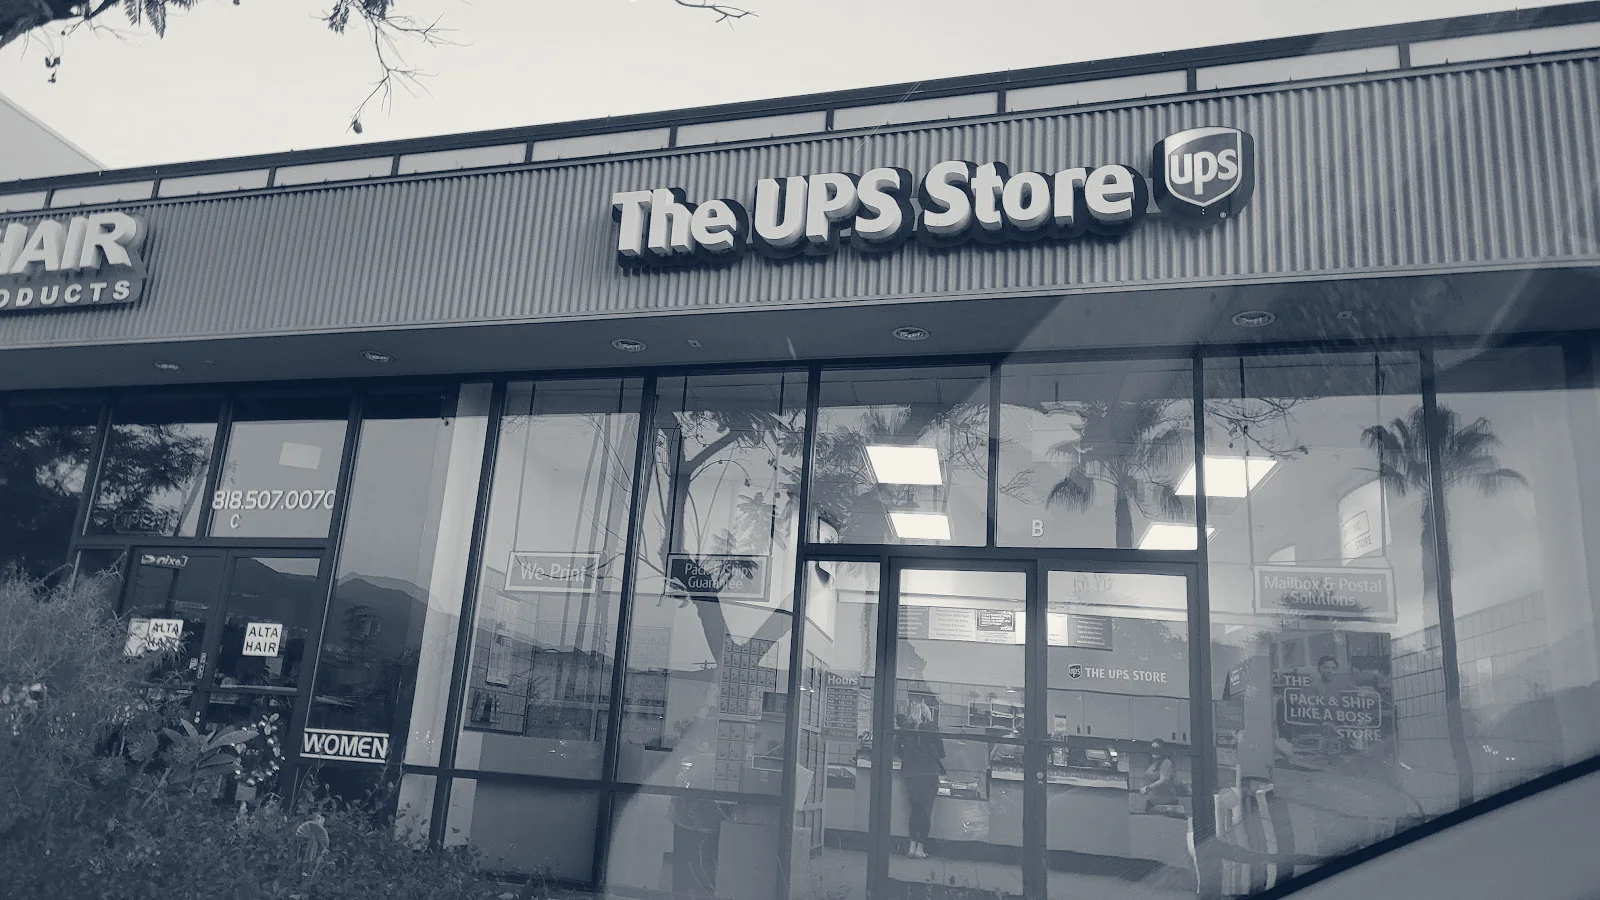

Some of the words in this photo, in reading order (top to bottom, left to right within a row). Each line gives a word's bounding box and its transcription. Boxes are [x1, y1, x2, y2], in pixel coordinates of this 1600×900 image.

[1170, 148, 1238, 196] ups
[613, 187, 737, 255] The
[754, 167, 904, 248] UPS
[924, 160, 1135, 237] Store
[212, 490, 336, 510] 818.507.0070
[230, 513, 240, 529] C
[1032, 519, 1044, 537] B
[520, 562, 545, 580] We
[549, 563, 587, 582] Print
[1264, 576, 1320, 591] Mailbox
[1323, 576, 1336, 591] &
[1339, 577, 1382, 593] Postal
[1290, 590, 1356, 606] Solutions
[248, 626, 279, 638] ALTA
[245, 641, 277, 653] HAIR
[827, 675, 858, 686] Hours
[1085, 667, 1105, 679] THE
[1108, 669, 1130, 680] UPS
[1132, 670, 1167, 683] STORE
[1284, 675, 1311, 687] THE
[1289, 693, 1325, 706] PACK
[1328, 695, 1339, 706] &
[1341, 695, 1375, 709] SHIP
[1290, 707, 1320, 720] LIKE
[1323, 708, 1333, 721] A
[1336, 710, 1373, 723] BOSS
[1336, 728, 1382, 742] STORE
[303, 732, 389, 760] WOMEN
